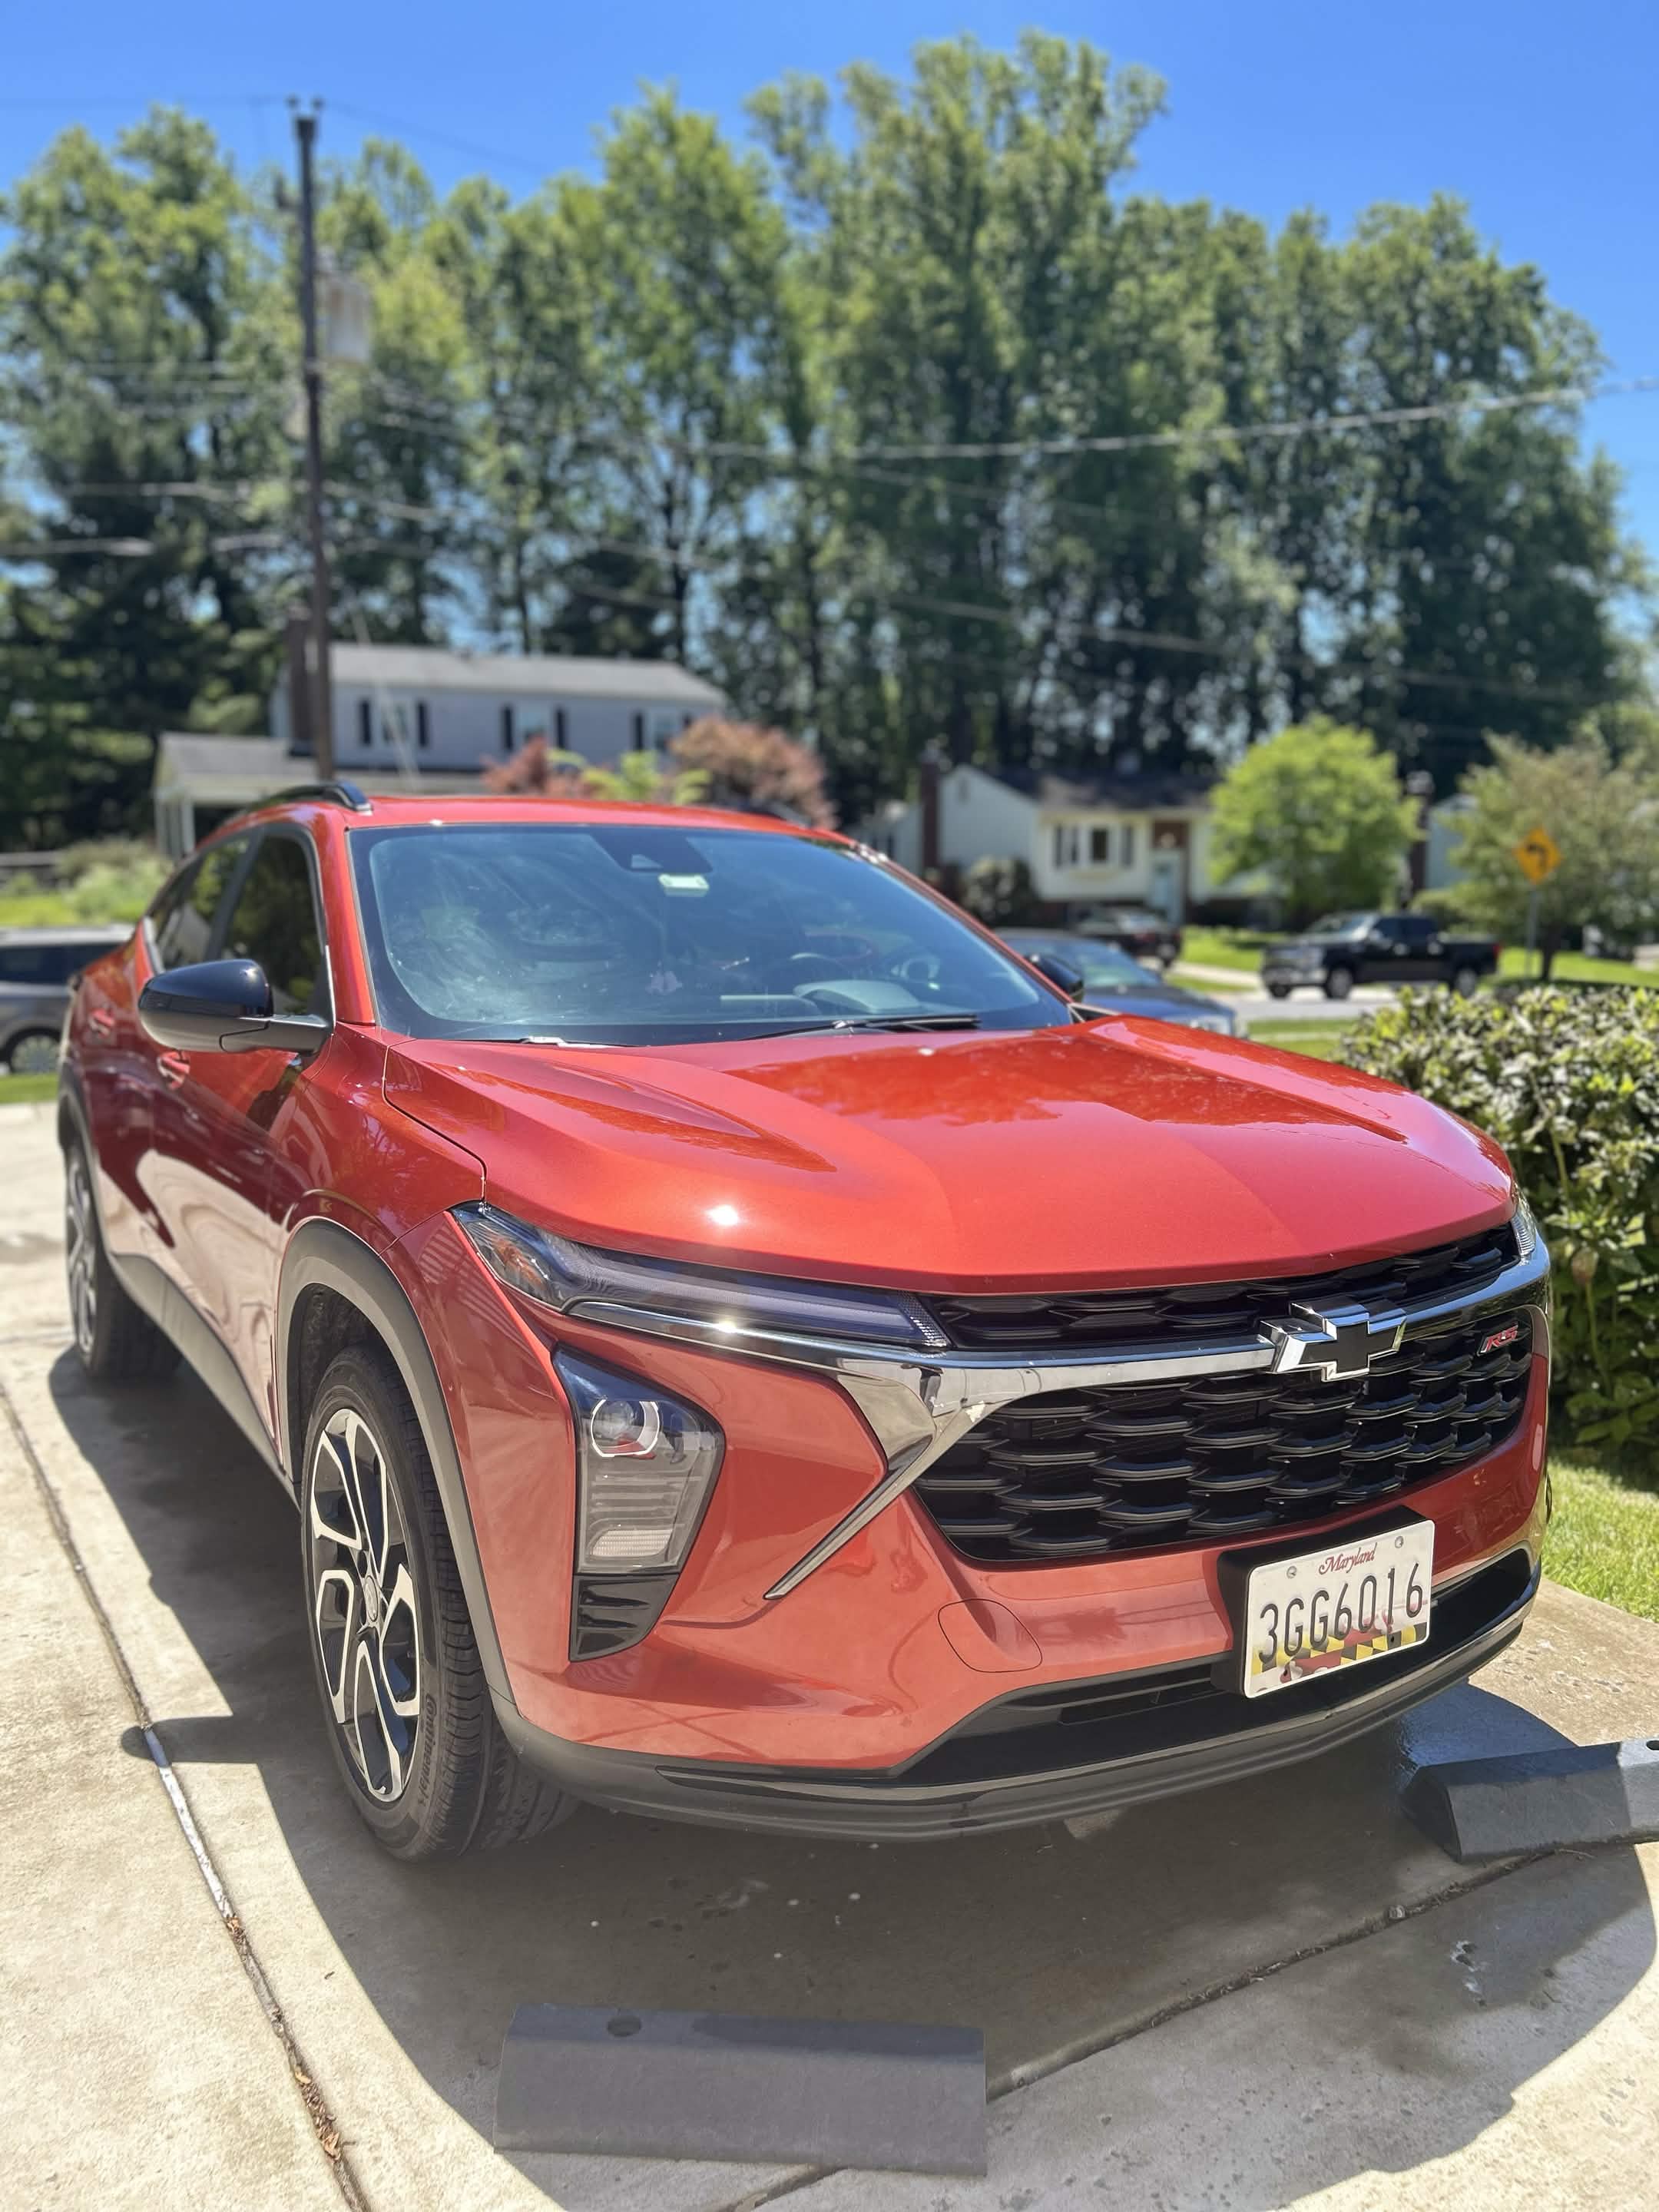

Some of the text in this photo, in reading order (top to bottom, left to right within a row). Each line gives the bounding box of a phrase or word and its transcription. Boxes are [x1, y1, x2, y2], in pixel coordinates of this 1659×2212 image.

[1480, 1325, 1518, 1353] RS
[1318, 1541, 1378, 1575] Maryland
[1258, 1562, 1423, 1665] 3GG6016
